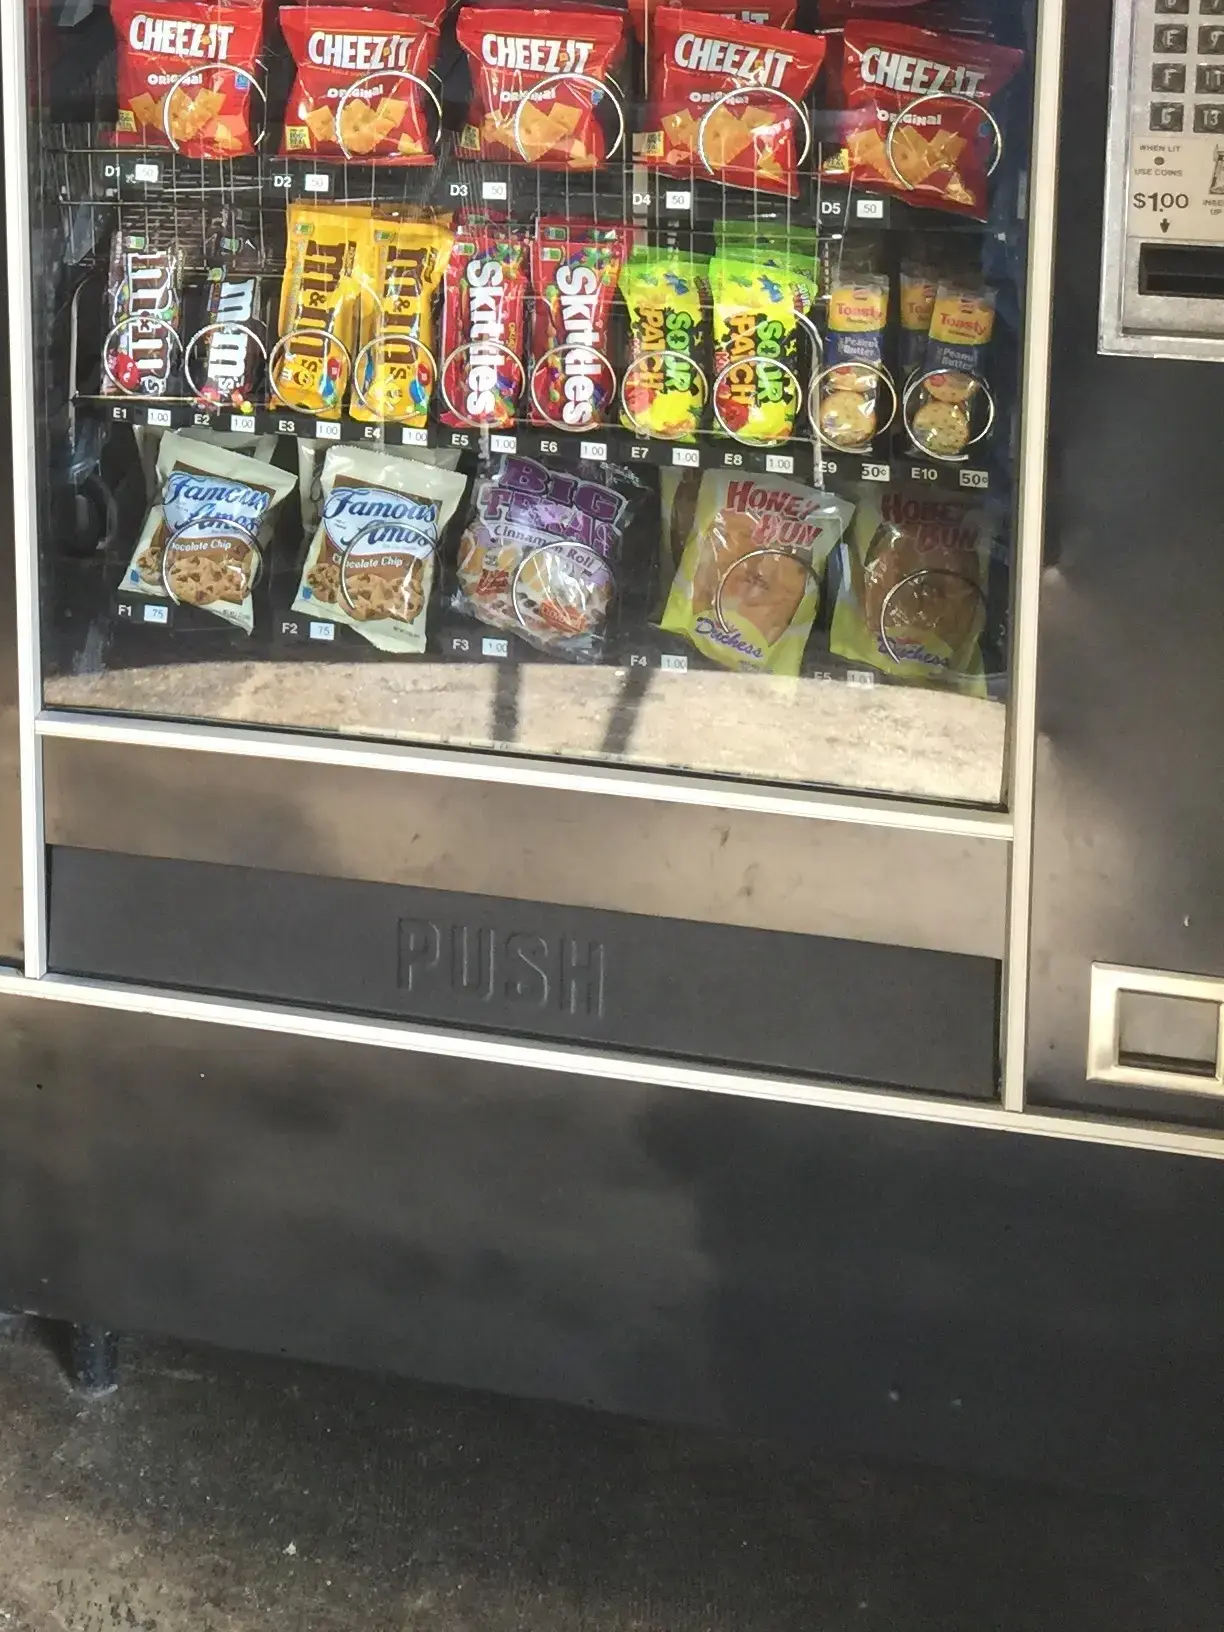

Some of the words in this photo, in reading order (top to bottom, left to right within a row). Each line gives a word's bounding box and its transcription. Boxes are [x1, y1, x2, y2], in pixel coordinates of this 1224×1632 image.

[104, 165, 121, 177] D1
[1154, 169, 1183, 177] COINS
[273, 176, 291, 188] D2
[449, 185, 468, 197] D3
[632, 193, 651, 205] D4
[1133, 192, 1189, 212] $1.00
[821, 202, 841, 215] D5
[940, 313, 987, 336] Toasty
[466, 259, 505, 416] Skittles
[556, 265, 602, 425] Skittles
[638, 305, 665, 391] PATCH
[664, 311, 691, 392] SOUR
[728, 314, 757, 406] PATCH
[755, 319, 783, 404] SOUR
[112, 407, 127, 419] E1
[149, 412, 169, 423] 1.00
[194, 414, 210, 425] E2
[233, 419, 253, 429] 1.00
[278, 419, 296, 432] E3
[364, 426, 381, 438] E4
[451, 433, 469, 446] E5
[540, 440, 558, 453] E6
[631, 447, 649, 458] E7
[675, 451, 698, 463] 1.00
[724, 453, 743, 465] E8
[818, 461, 837, 473] E9
[911, 468, 938, 481] E10
[163, 473, 270, 514] Famous
[323, 487, 436, 523] Famous
[726, 480, 821, 521] HONEY
[210, 538, 232, 550] Chip
[381, 555, 403, 568] Chip
[566, 548, 594, 568] Roll
[118, 605, 132, 616] F1
[281, 622, 298, 634] F2
[694, 616, 764, 659] Duchess
[452, 639, 469, 651] F3
[630, 655, 647, 667] F4
[397, 917, 604, 1018] PUSH
